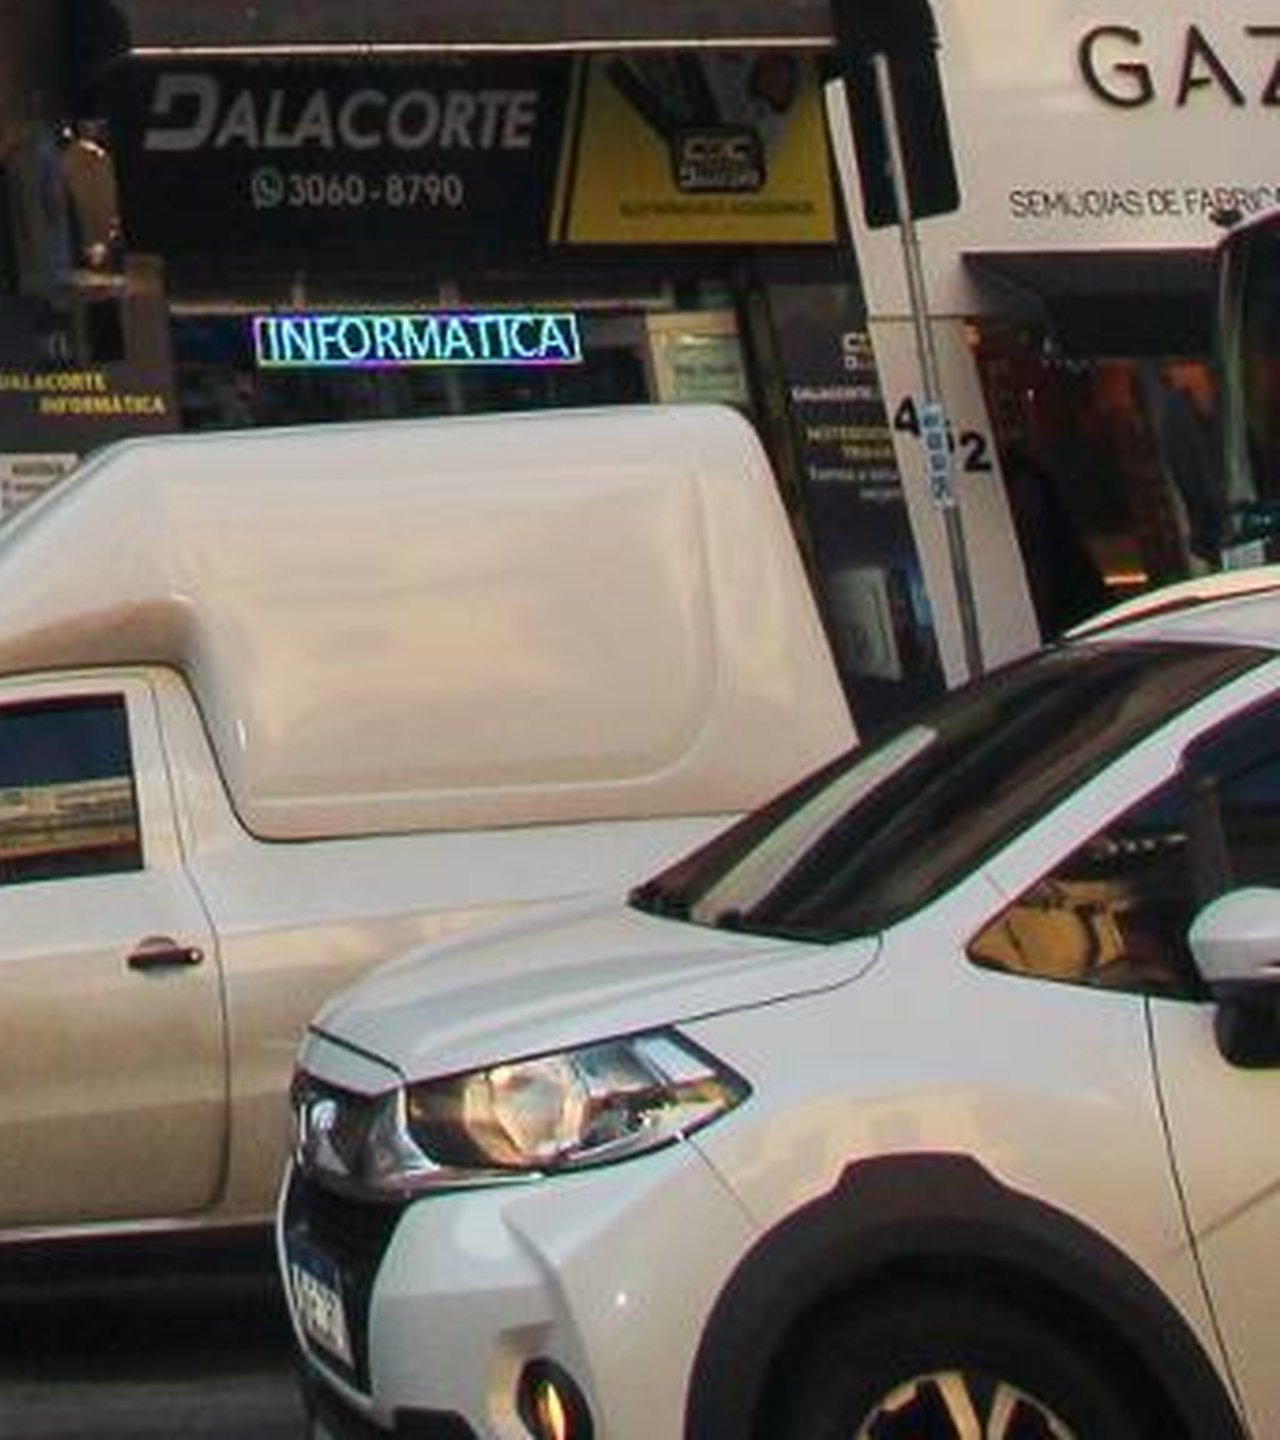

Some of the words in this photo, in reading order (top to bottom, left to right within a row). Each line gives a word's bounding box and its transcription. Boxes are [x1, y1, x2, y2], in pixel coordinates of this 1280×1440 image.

[143, 73, 539, 151] DALACORTE
[1008, 189, 1143, 218] SEMIJOIAS
[1147, 188, 1182, 215] DE
[267, 315, 571, 361] INFORMATICA
[894, 396, 993, 473] 42
